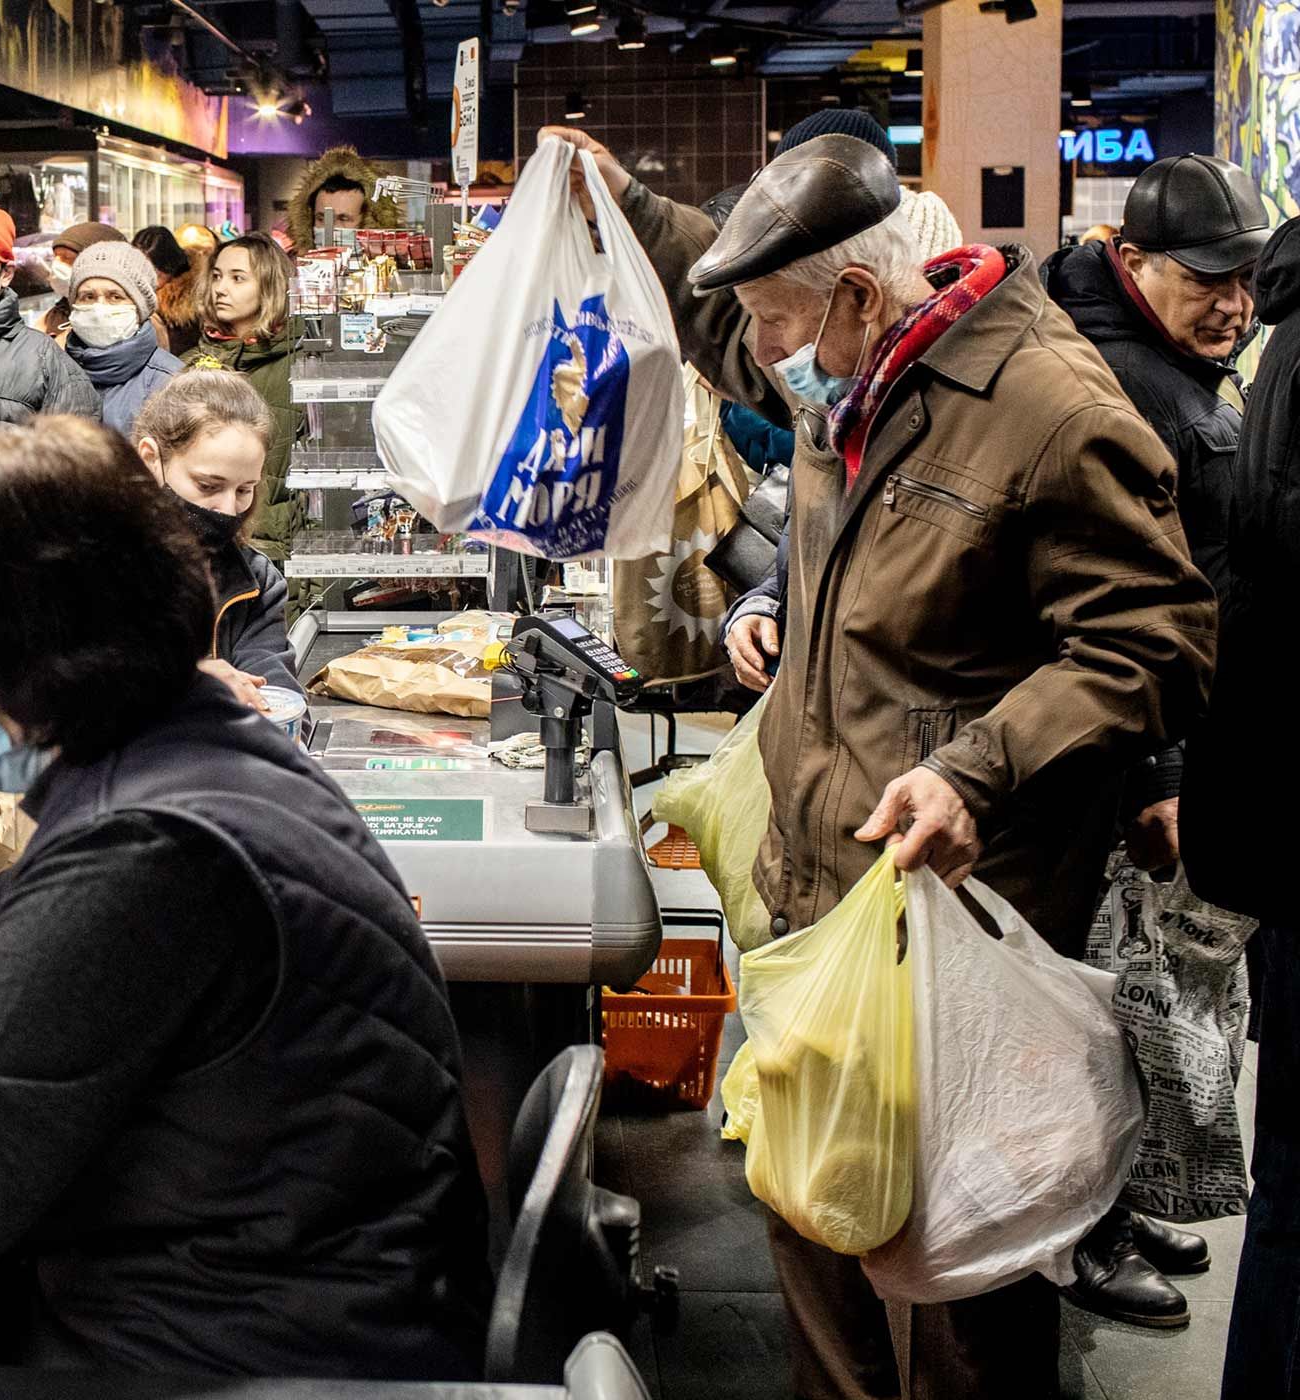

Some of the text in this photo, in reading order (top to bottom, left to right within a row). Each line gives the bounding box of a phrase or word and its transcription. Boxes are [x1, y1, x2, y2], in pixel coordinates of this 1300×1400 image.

[1059, 129, 1154, 161] ИБА
[494, 471, 603, 530] МОРЯ
[1151, 1071, 1193, 1095] Paris
[1147, 1187, 1246, 1217] NEWS
